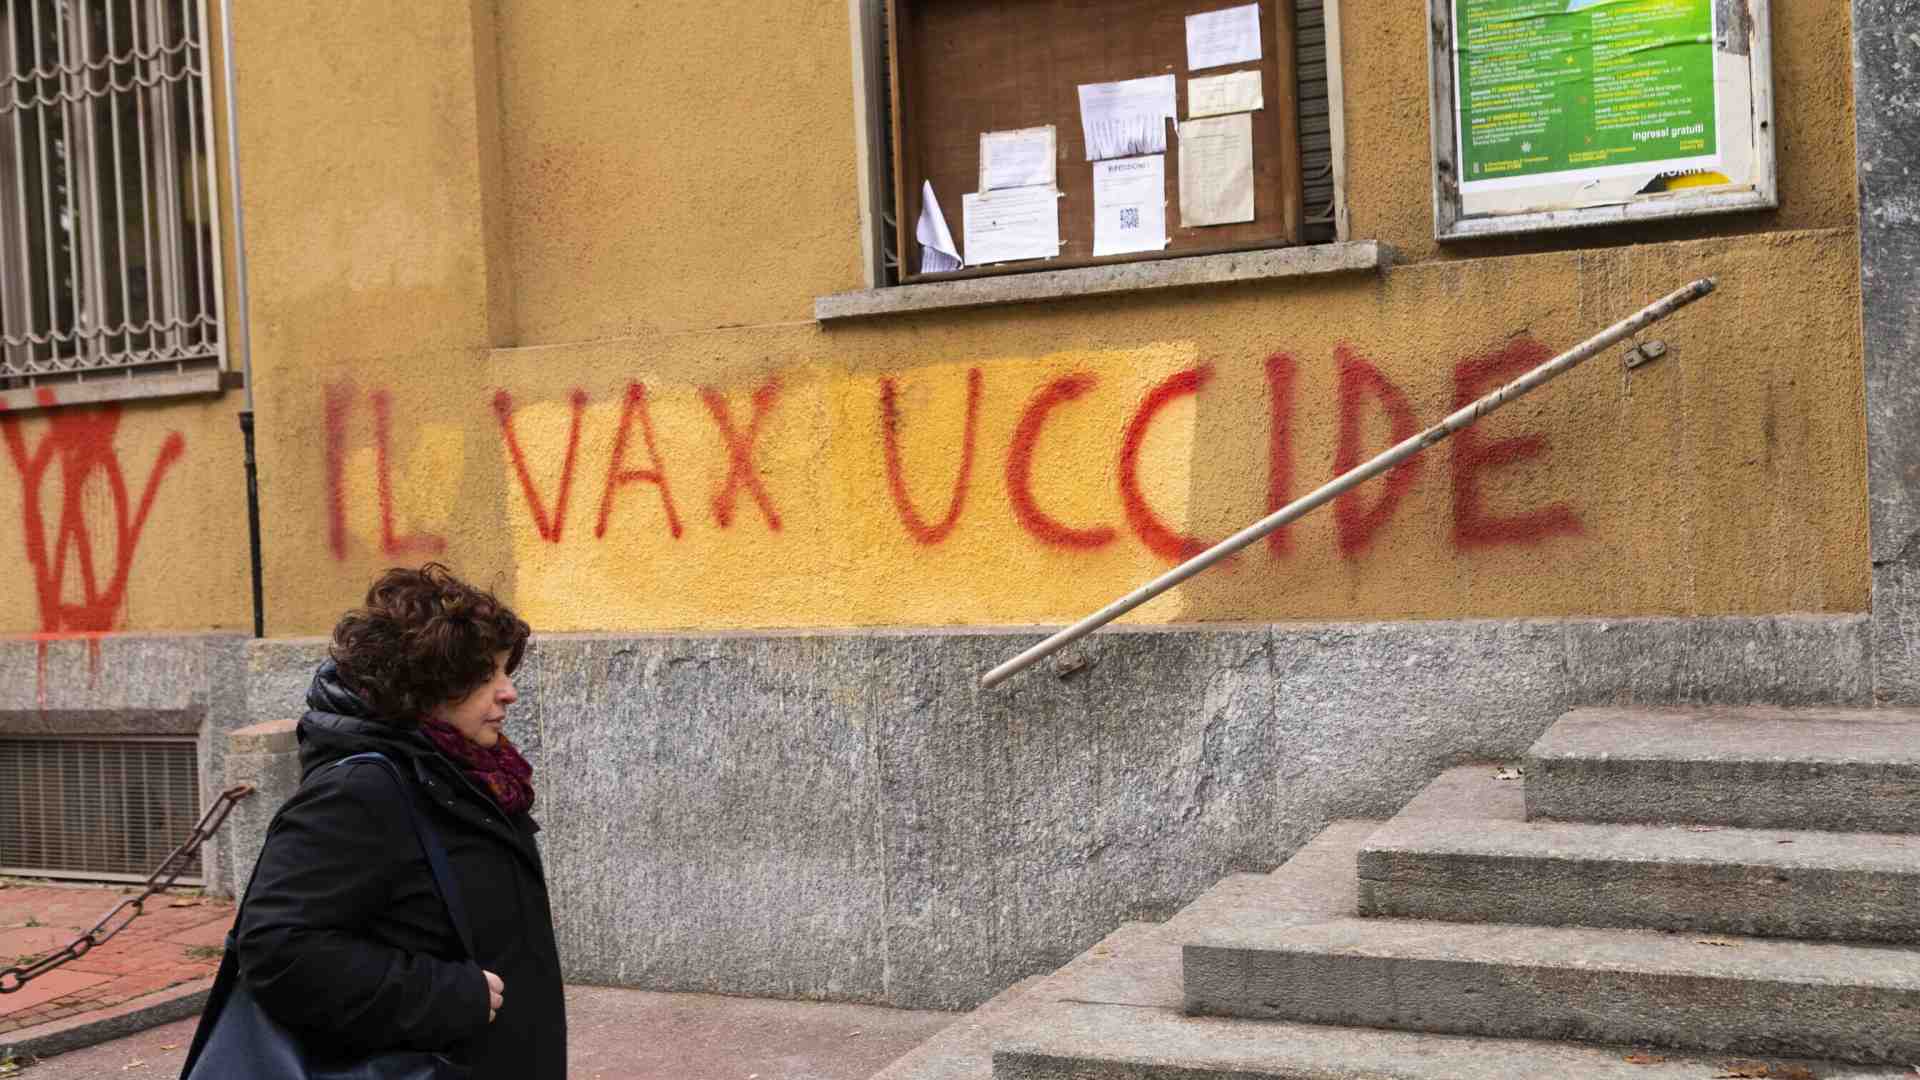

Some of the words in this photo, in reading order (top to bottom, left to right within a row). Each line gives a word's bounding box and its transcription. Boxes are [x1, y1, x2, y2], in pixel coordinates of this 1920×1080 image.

[1632, 127, 1669, 142] ingressi
[1671, 123, 1704, 137] gratuiti
[324, 384, 447, 560] IL
[492, 373, 783, 544] VAX
[880, 337, 1587, 569] UCCIDE
